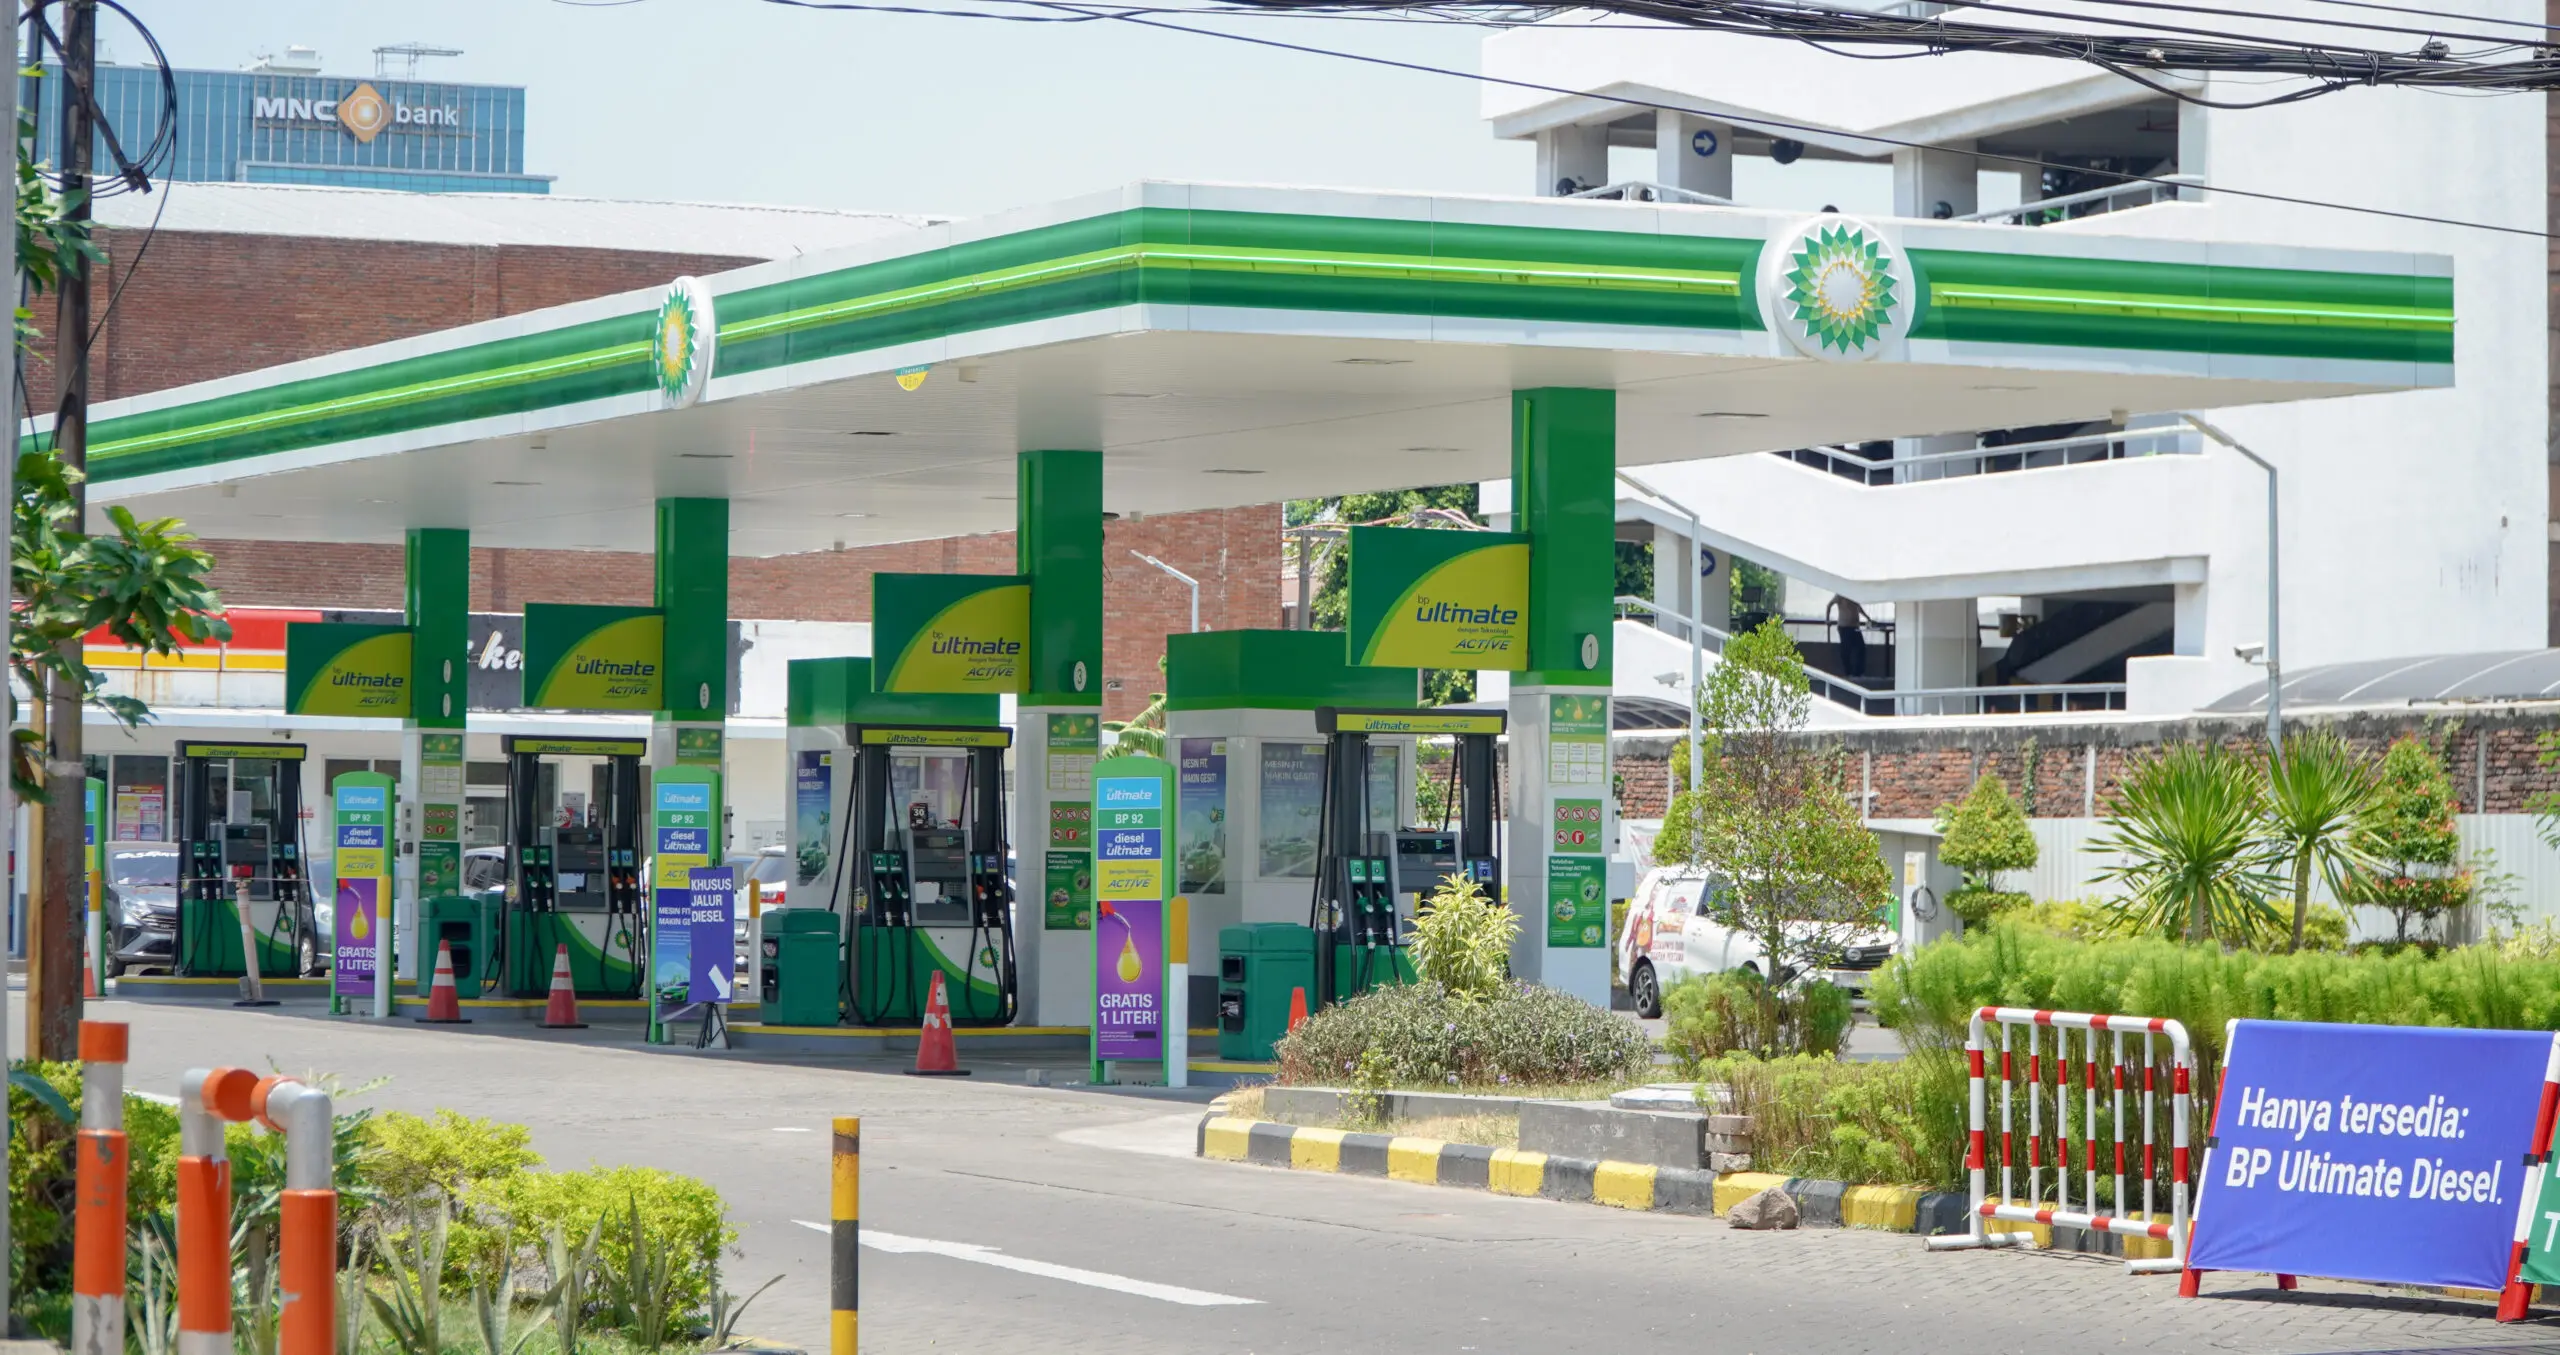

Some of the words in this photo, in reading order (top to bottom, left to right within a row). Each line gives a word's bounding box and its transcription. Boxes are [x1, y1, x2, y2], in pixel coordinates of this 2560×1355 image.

[255, 96, 338, 122] MNC
[395, 102, 458, 126] bank
[1417, 593, 1430, 605] bp
[1416, 602, 1518, 625] ultimate
[932, 636, 1021, 655] ultimate
[1455, 639, 1511, 651] ACTIVE
[1587, 642, 1593, 661] 1
[575, 658, 656, 676] ultimate
[966, 667, 1015, 677] ACTIVE
[332, 672, 404, 688] ultimate
[1077, 668, 1083, 684] 3
[605, 686, 650, 695] ACTIVE
[359, 696, 399, 705] ACTIVE
[1365, 719, 1411, 731] ultimate
[886, 733, 928, 743] ultimate
[663, 793, 702, 804] ultimate
[1106, 788, 1153, 801] ultimate
[349, 813, 361, 822] BP
[362, 813, 371, 822] 92
[913, 808, 925, 817] 30
[1115, 813, 1129, 824] BP
[1131, 813, 1144, 824] 92
[671, 814, 683, 824] BP
[684, 814, 695, 824] 92
[349, 828, 372, 837] diesel
[670, 831, 695, 841] diesel
[1114, 832, 1145, 844] diesel
[343, 837, 378, 846] ultimate
[663, 841, 702, 851] ultimate
[1106, 845, 1153, 856] ultimate
[664, 870, 690, 878] ACTI
[691, 878, 733, 891] KHUSUS
[1107, 879, 1152, 888] ACTIVE
[690, 894, 723, 907] JALUR
[658, 907, 681, 915] MESIN
[691, 910, 726, 923] DIESEL
[658, 918, 681, 926] MAKIN
[337, 946, 376, 958] GRATIS
[338, 960, 344, 970] 1
[1100, 993, 1153, 1009] GRATIS
[1101, 1011, 1108, 1025] 1
[1112, 1011, 1157, 1025] LITER!
[2237, 1086, 2332, 1141] Hanya
[2339, 1093, 2469, 1139] tersedia:
[2225, 1147, 2272, 1189] BP
[2278, 1149, 2403, 1199] Ultimate
[2409, 1157, 2503, 1205] Diesel.
